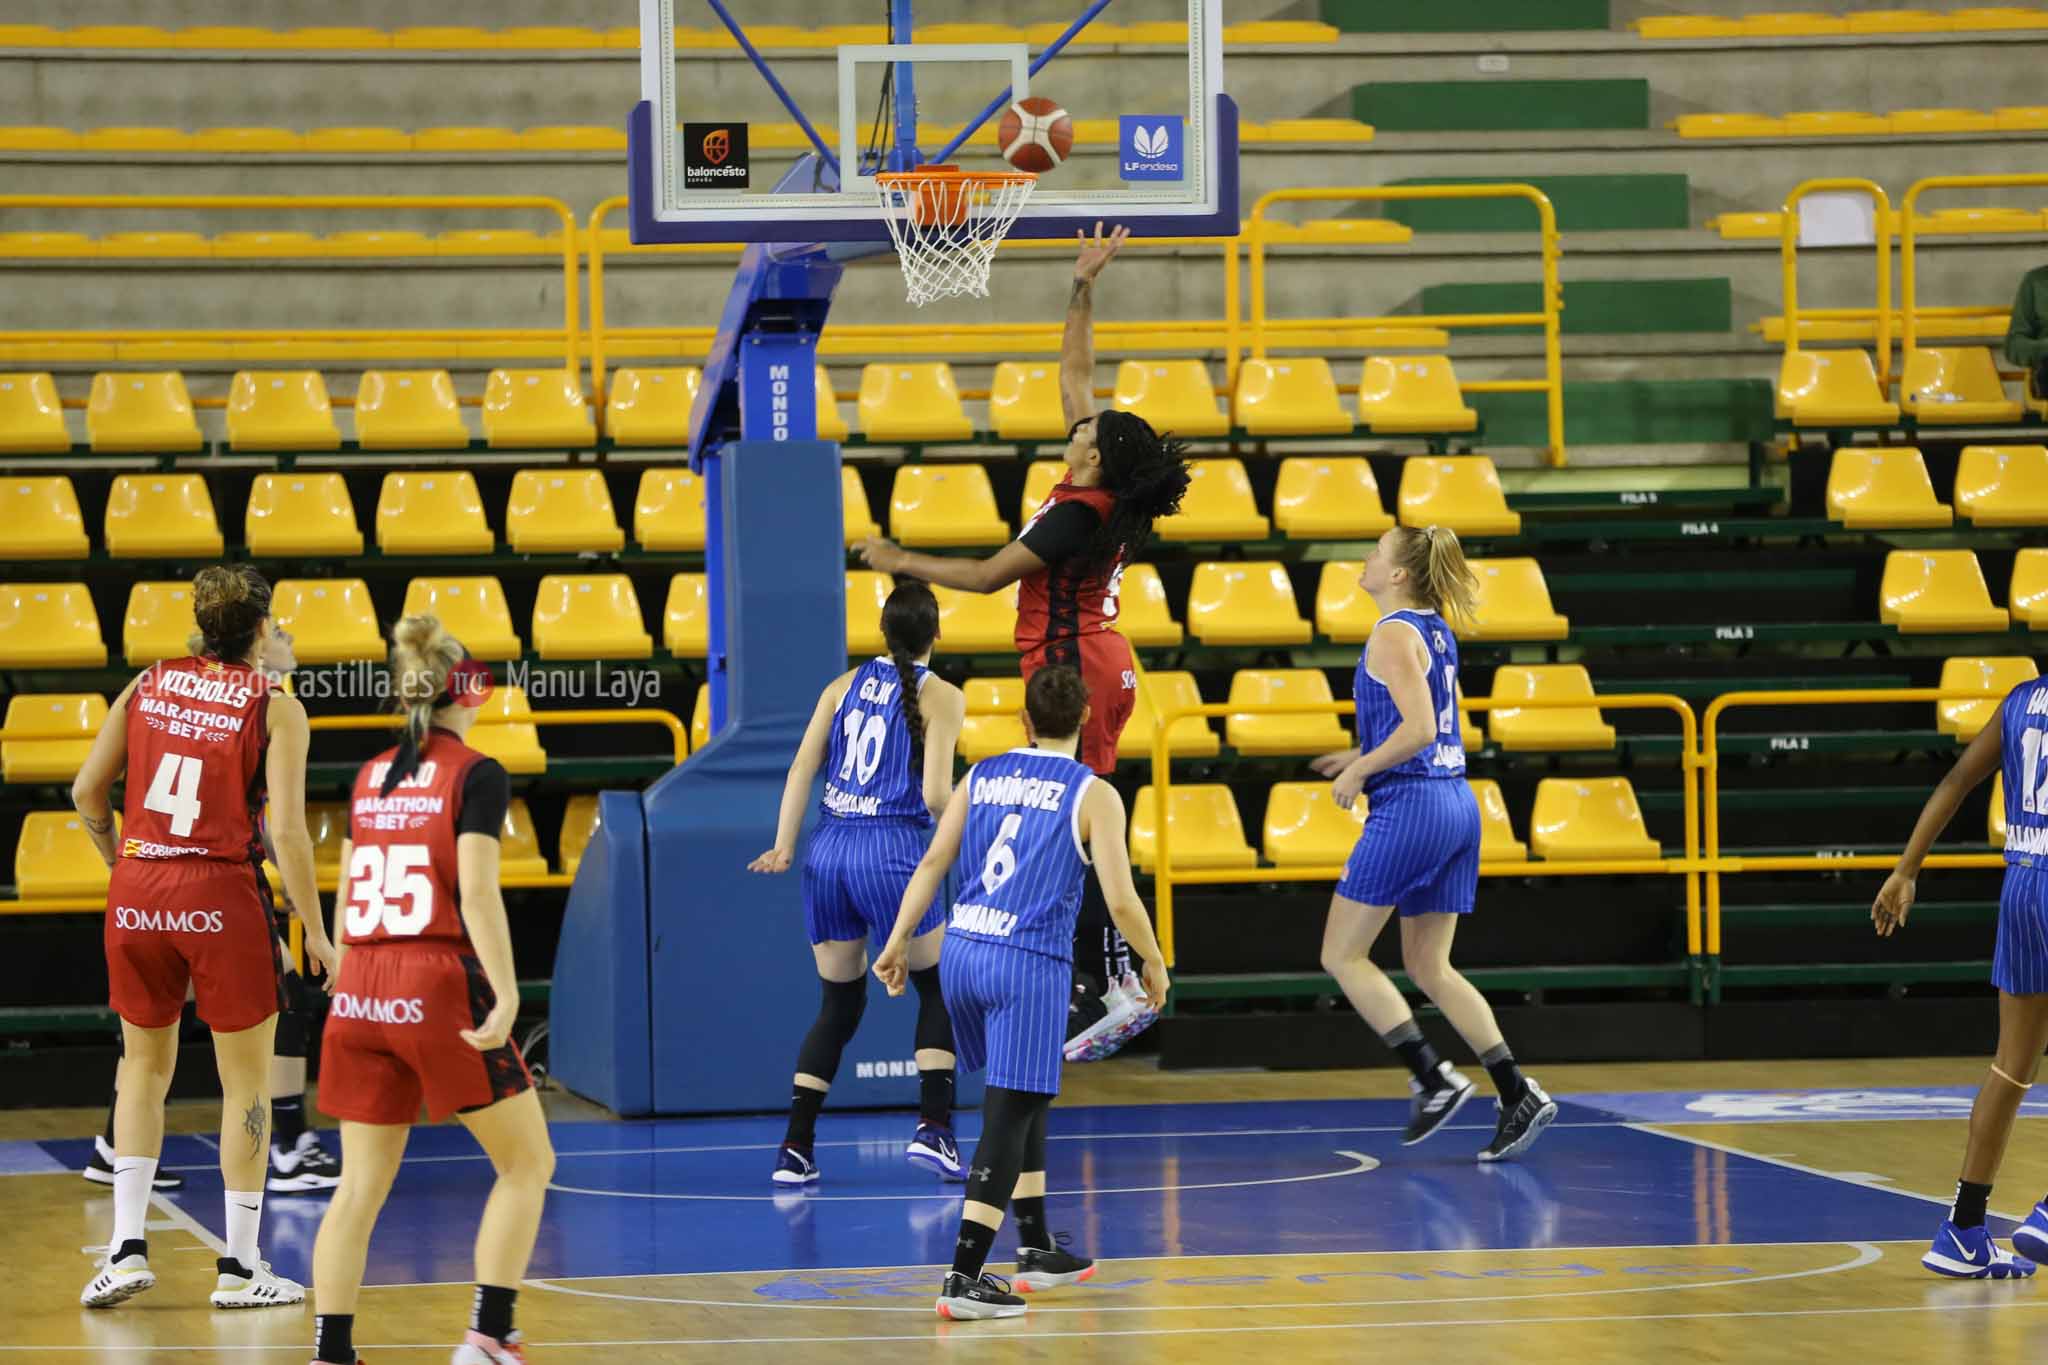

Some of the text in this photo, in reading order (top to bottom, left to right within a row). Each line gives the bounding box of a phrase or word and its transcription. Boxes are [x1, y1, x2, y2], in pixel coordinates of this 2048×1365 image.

[687, 165, 746, 177] baloncesto
[769, 365, 789, 441] MONDO
[1620, 492, 1647, 504] FILA
[1681, 522, 1719, 535] FILA 4
[1715, 626, 1744, 639] FILA
[159, 669, 251, 709] NICHOLLS
[139, 698, 244, 732] MARATHON
[168, 720, 206, 741] BET
[838, 708, 887, 787] 10
[1770, 737, 1798, 750] FILA
[143, 751, 204, 838] 4
[972, 768, 1067, 813] DOMÍNGUEZ
[374, 813, 409, 831] BET
[142, 842, 209, 857] GOBIERNO
[981, 812, 1023, 897] 6
[344, 844, 434, 938] 35
[115, 906, 224, 933] SOMMOS
[855, 1060, 919, 1079] MOND
